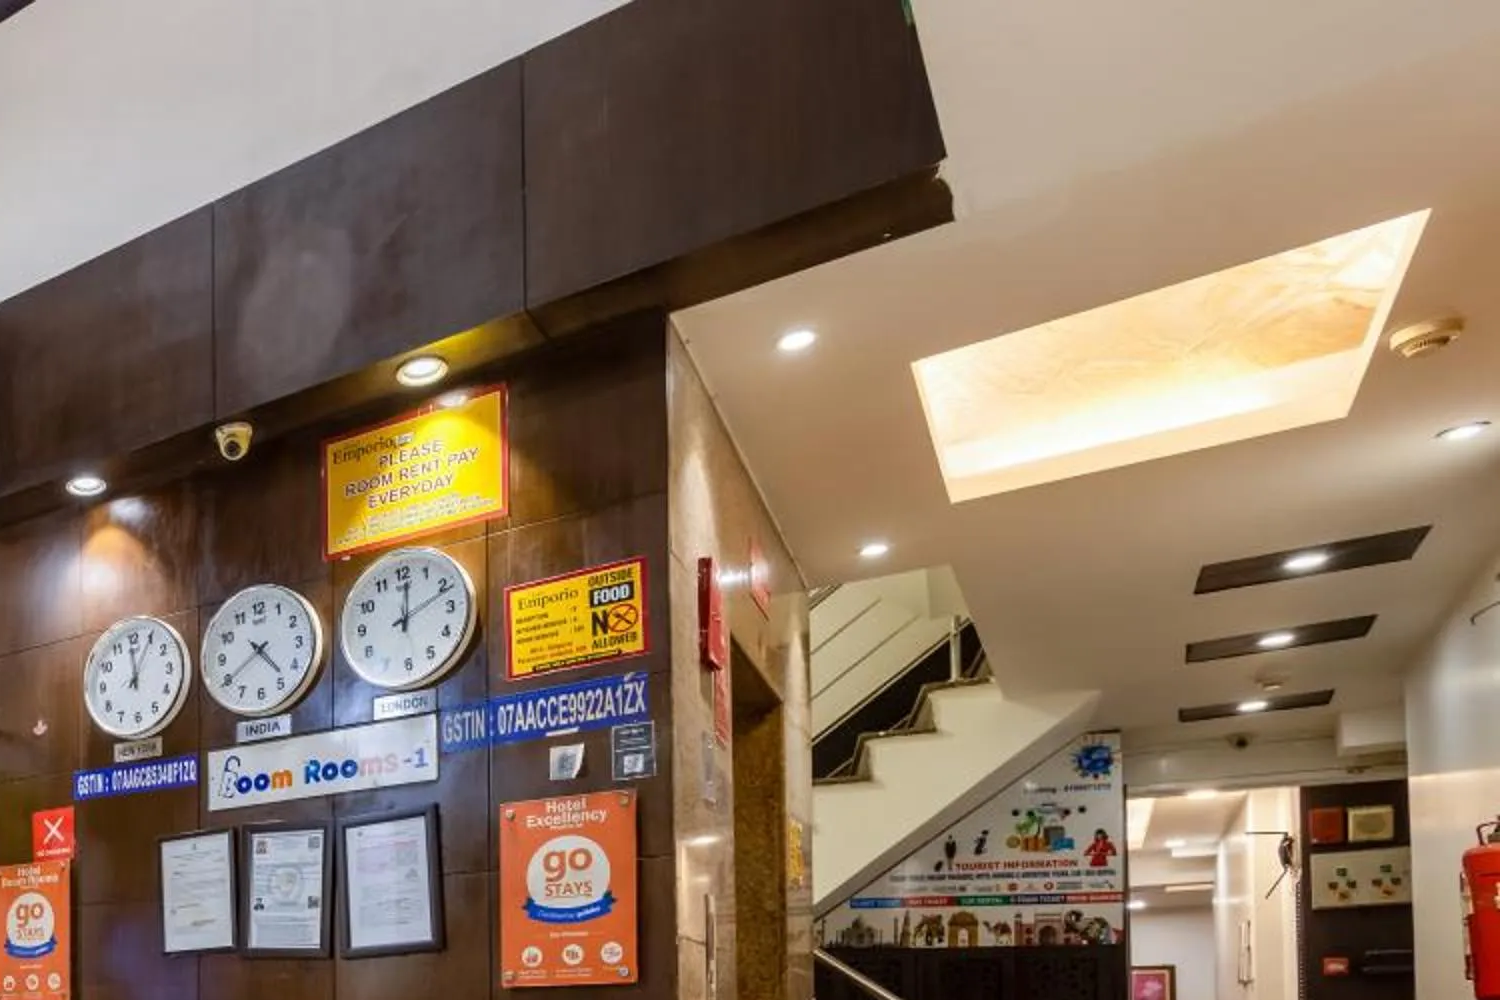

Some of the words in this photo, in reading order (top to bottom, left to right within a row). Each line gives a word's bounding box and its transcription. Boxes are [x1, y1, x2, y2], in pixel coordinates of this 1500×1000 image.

[379, 440, 443, 468] PLEASE
[345, 472, 393, 497] ROOM
[400, 459, 440, 481] RENT
[448, 447, 479, 466] PAY
[368, 474, 454, 508] EVERYDAY
[395, 566, 411, 581] 12
[422, 566, 429, 580] 1
[587, 567, 634, 587] OUTSIDE
[376, 578, 388, 593] 11
[593, 584, 630, 605] FOOD
[252, 601, 265, 615] 12
[276, 603, 281, 616] 1
[360, 599, 375, 614] 10
[446, 600, 455, 614] 3
[235, 612, 245, 625] 11
[289, 615, 297, 628] 2
[357, 624, 367, 637] 9
[441, 625, 451, 637] 4
[127, 632, 139, 645] 12
[221, 631, 234, 644] 10
[295, 635, 303, 648] 3
[592, 632, 637, 650] ALLOWED
[113, 643, 123, 656] 11
[159, 643, 167, 656] 2
[426, 646, 435, 659] 5
[218, 653, 226, 666] 9
[404, 658, 413, 671] 6
[100, 660, 113, 673] 10
[165, 661, 173, 674] 3
[100, 681, 106, 694] 9
[162, 683, 170, 694] 4
[276, 677, 285, 690] 5
[239, 685, 247, 698] 7
[257, 688, 265, 700] 6
[105, 700, 112, 712] 8
[151, 701, 159, 714] 5
[382, 697, 428, 713] LONDON
[443, 709, 486, 743] GSTIN
[497, 680, 646, 735] 07AACCE9922A1ZX
[116, 710, 125, 723] 7
[135, 711, 142, 723] 6
[245, 722, 280, 737] INDIA
[77, 773, 104, 797] GSTIN
[546, 797, 587, 813] Hotel
[526, 808, 608, 828] Excellency
[543, 848, 593, 882] go
[545, 880, 593, 897] STAYS
[16, 903, 44, 928] go
